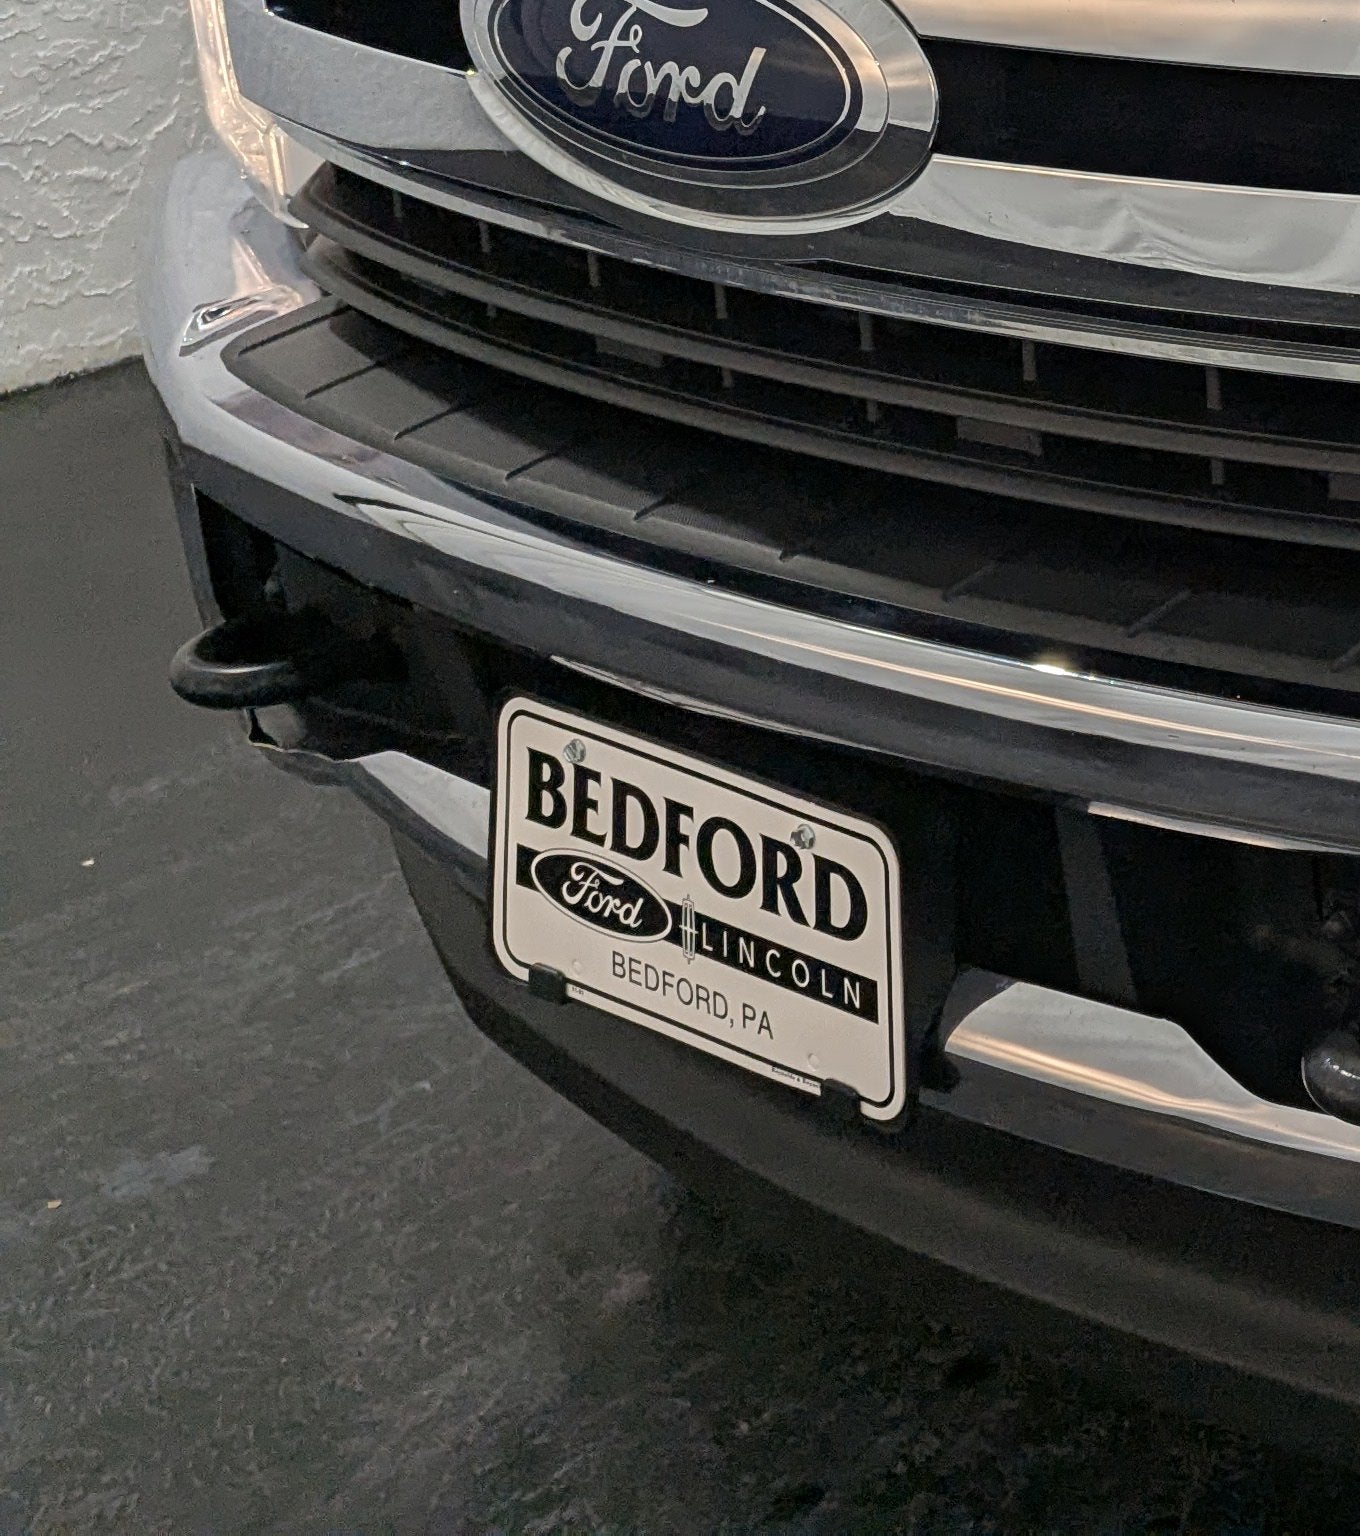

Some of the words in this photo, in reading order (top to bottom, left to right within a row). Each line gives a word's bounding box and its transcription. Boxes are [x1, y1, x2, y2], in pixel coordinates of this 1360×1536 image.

[525, 746, 868, 942] BEDFORD
[561, 861, 644, 930] Ford
[611, 950, 734, 1027] BEDFORD,
[741, 1002, 775, 1040] PA
[700, 921, 862, 1010] LINCOLN
